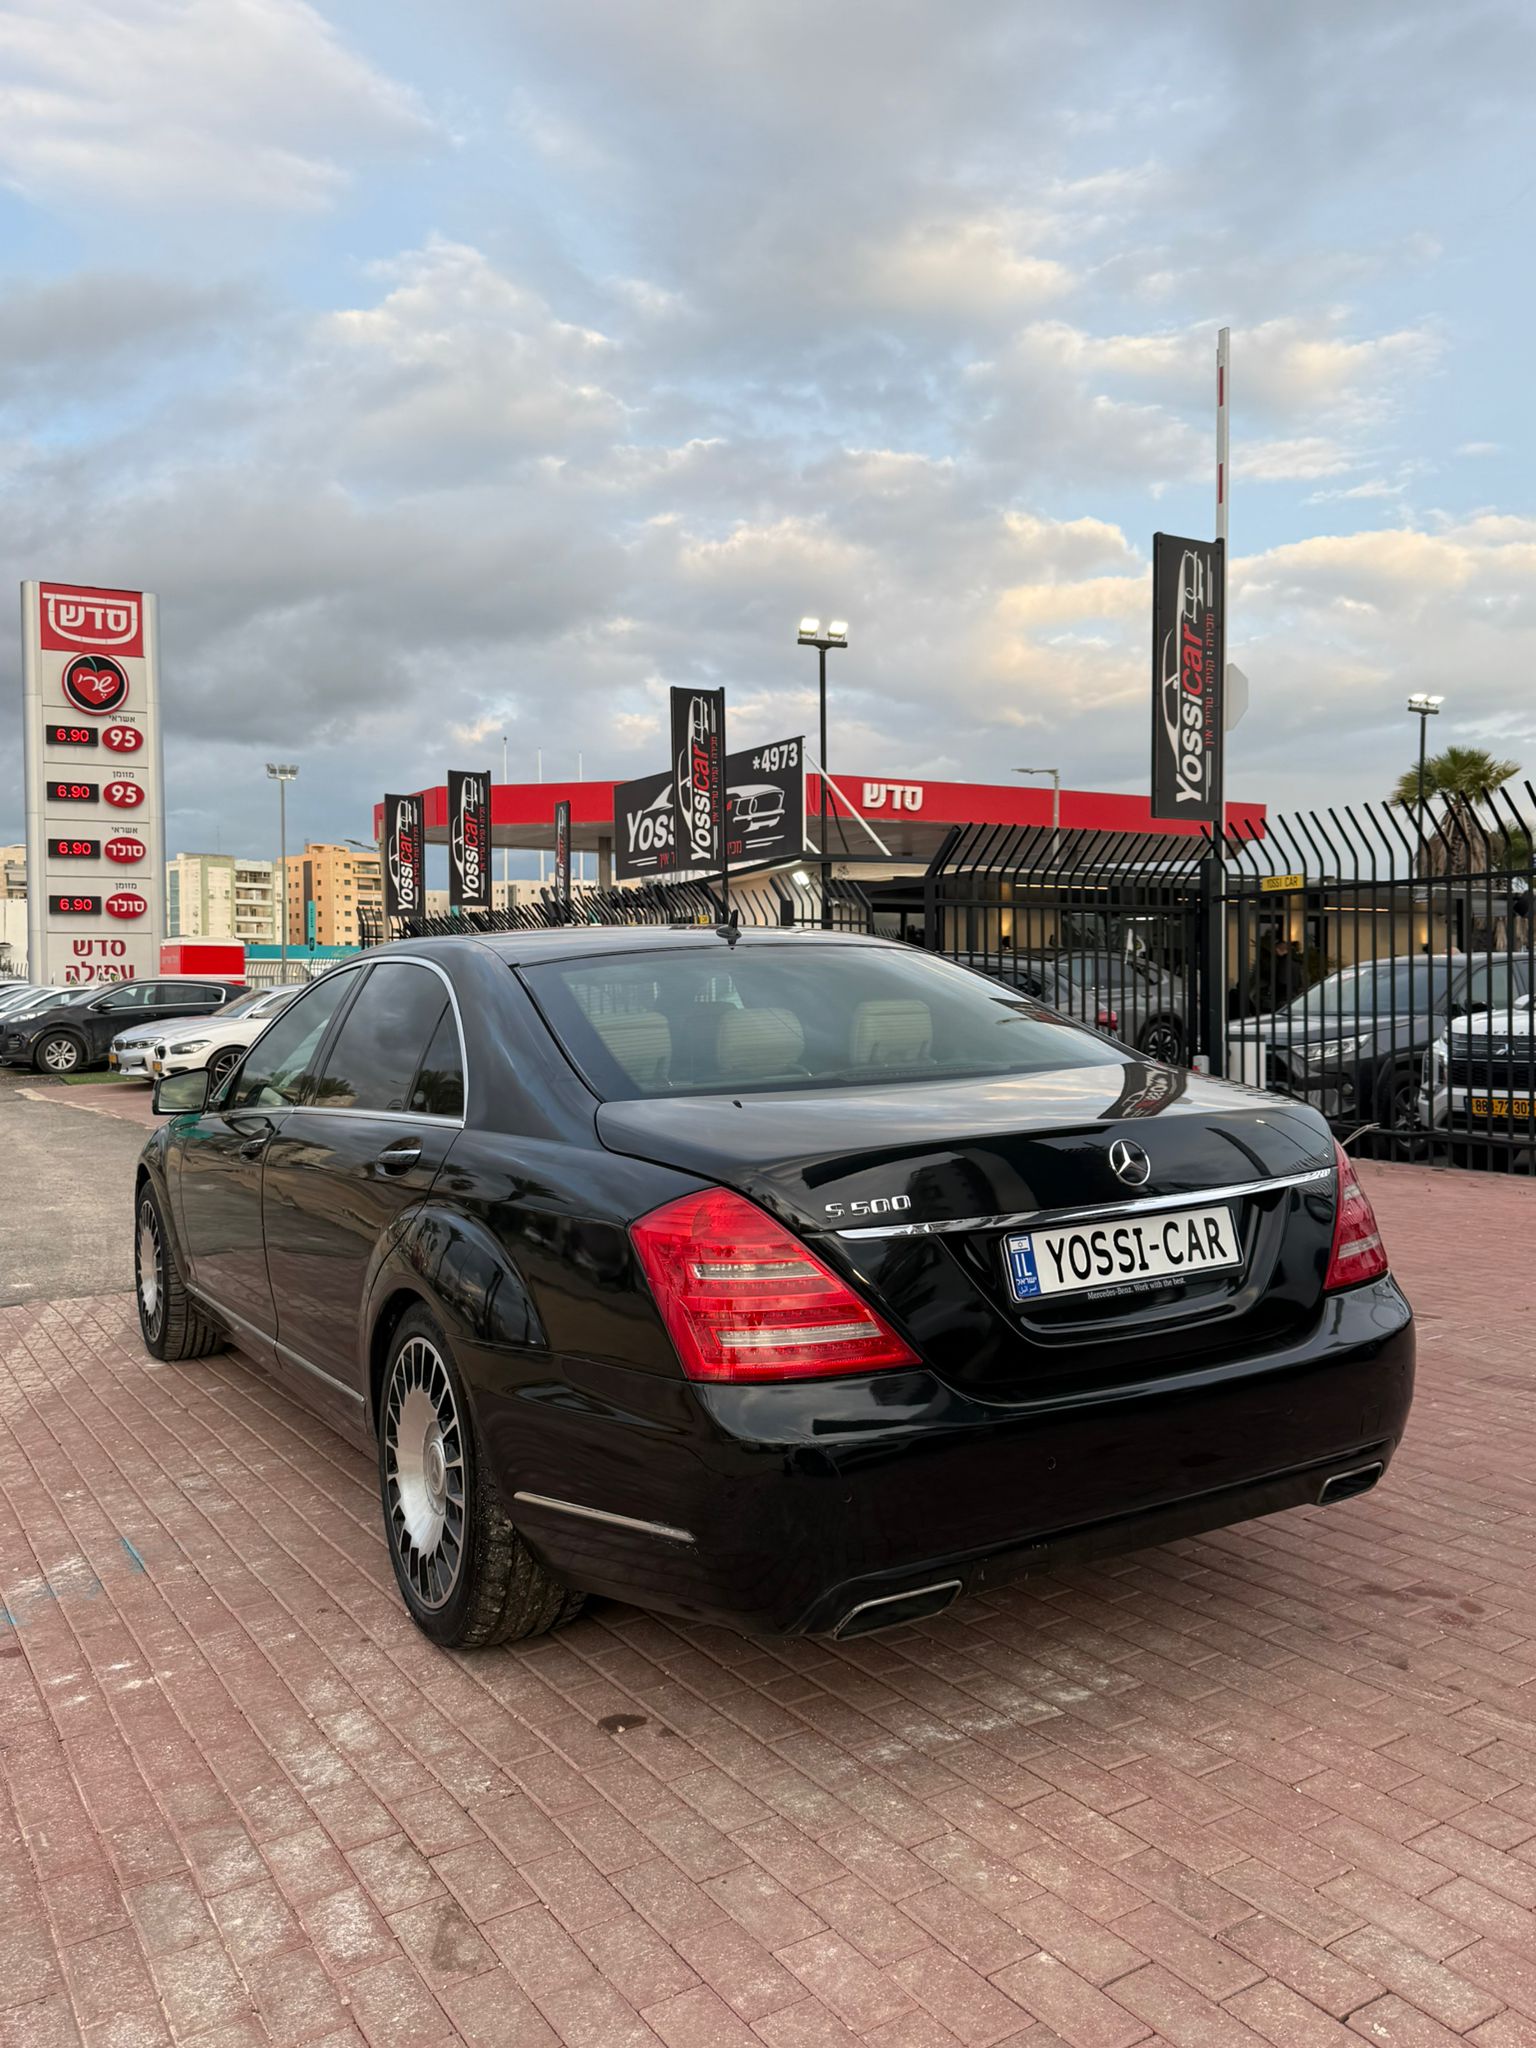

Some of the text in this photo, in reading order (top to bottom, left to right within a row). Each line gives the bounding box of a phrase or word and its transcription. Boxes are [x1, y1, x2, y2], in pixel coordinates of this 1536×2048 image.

[60, 604, 127, 632] סדש
[78, 674, 116, 697] שרי
[1204, 613, 1215, 746] מכירה קניה טרייד אין
[109, 715, 135, 723] אשראי
[56, 728, 89, 743] 6.90
[110, 729, 136, 748] 95
[112, 771, 135, 779] מזומן
[57, 784, 90, 799] 6.90
[111, 784, 137, 804] 95
[862, 782, 923, 811] סדש
[111, 826, 138, 834] אשראי
[58, 841, 92, 855] 6.90
[107, 842, 144, 857] סולר
[115, 882, 137, 891] מזומן
[59, 898, 92, 911] 6.90
[108, 898, 145, 913] סולר
[73, 939, 127, 957] סדש
[825, 1194, 912, 1219] S 500
[1045, 1217, 1228, 1283] YOSSI-CAR
[1015, 1253, 1032, 1277] IL
[1134, 1283, 1150, 1292] Work
[1150, 1281, 1163, 1289] with
[1163, 1279, 1173, 1287] the
